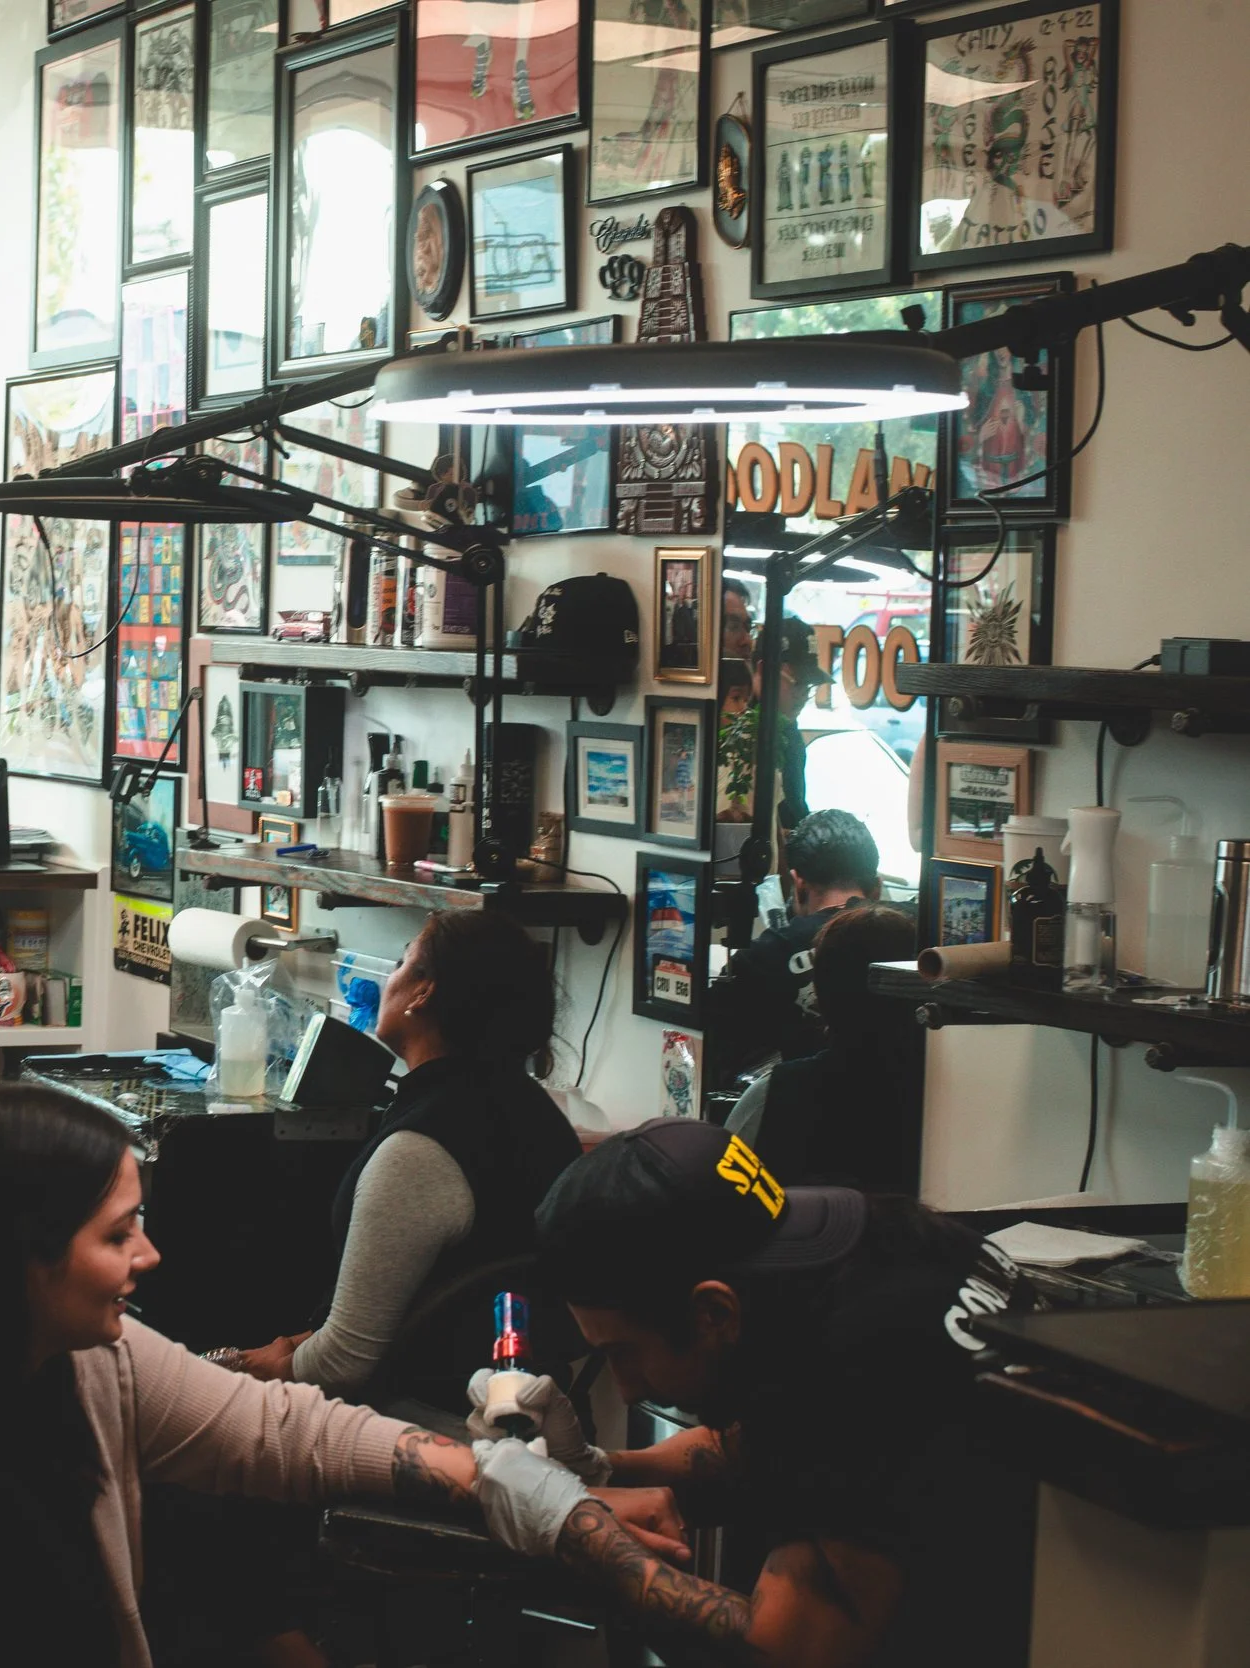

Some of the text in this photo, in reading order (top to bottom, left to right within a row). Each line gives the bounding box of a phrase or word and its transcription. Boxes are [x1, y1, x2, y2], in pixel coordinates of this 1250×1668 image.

[961, 209, 1047, 244] TATTOO
[133, 914, 171, 948] FELIX
[133, 940, 171, 960] CHEVROLET
